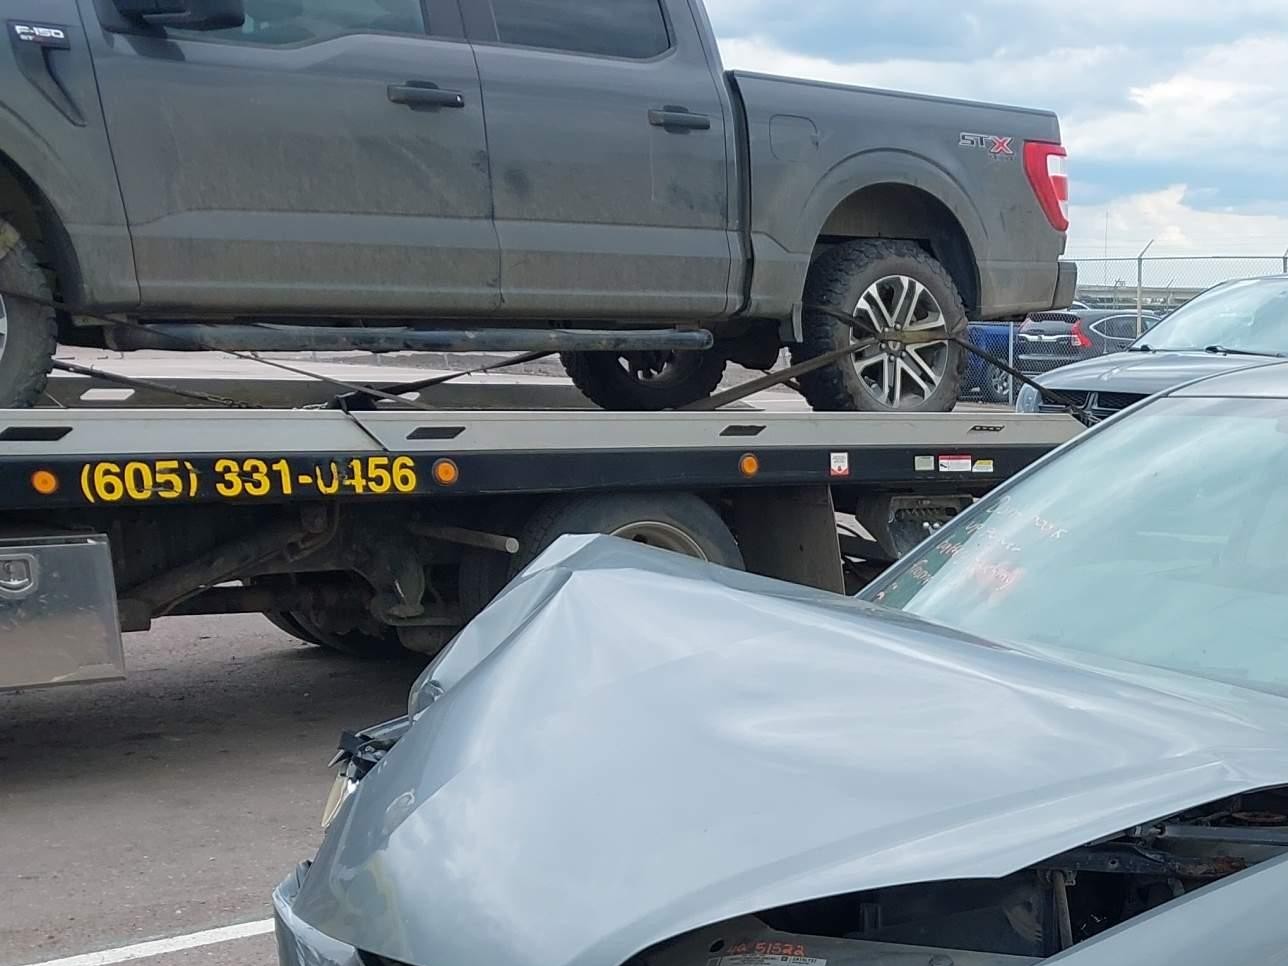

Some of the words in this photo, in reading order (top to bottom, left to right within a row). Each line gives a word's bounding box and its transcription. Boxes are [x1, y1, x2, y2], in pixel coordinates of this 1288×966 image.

[15, 25, 65, 39] F-150
[959, 132, 1014, 153] STX
[80, 460, 198, 503] (605)
[214, 455, 417, 496] 331-0456
